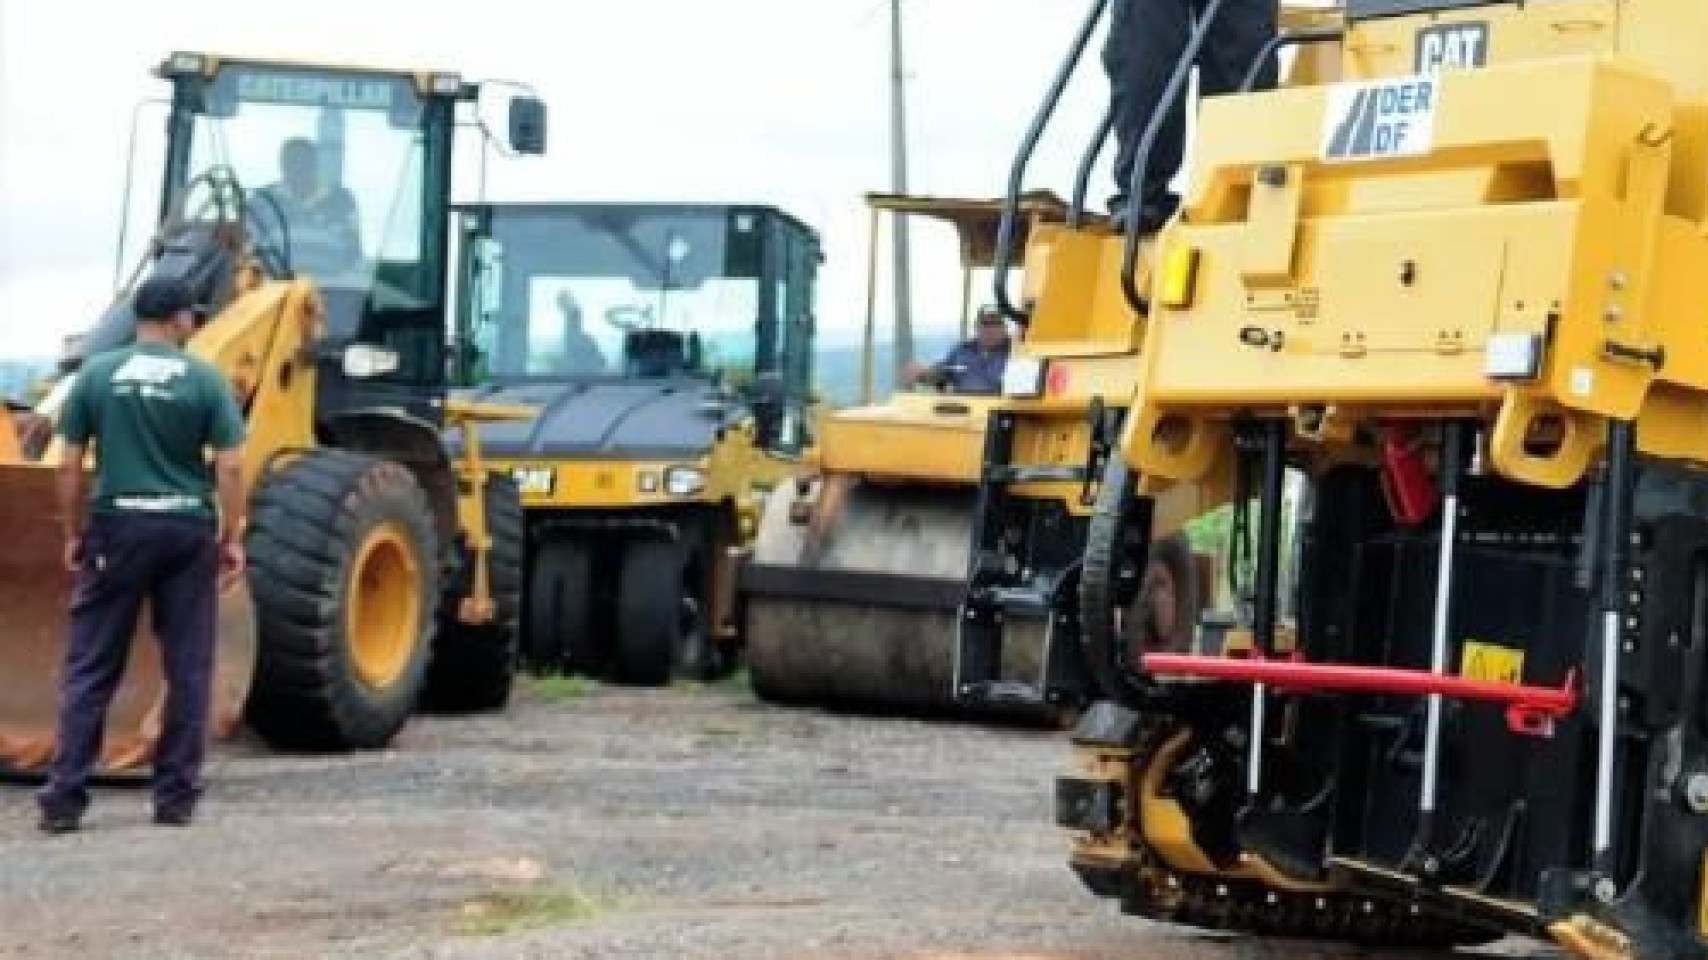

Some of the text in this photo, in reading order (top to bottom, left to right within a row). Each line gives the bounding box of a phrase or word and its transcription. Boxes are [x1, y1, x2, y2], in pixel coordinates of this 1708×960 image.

[1420, 29, 1481, 78] CAT
[1379, 81, 1433, 115] DER
[1375, 123, 1409, 152] DF
